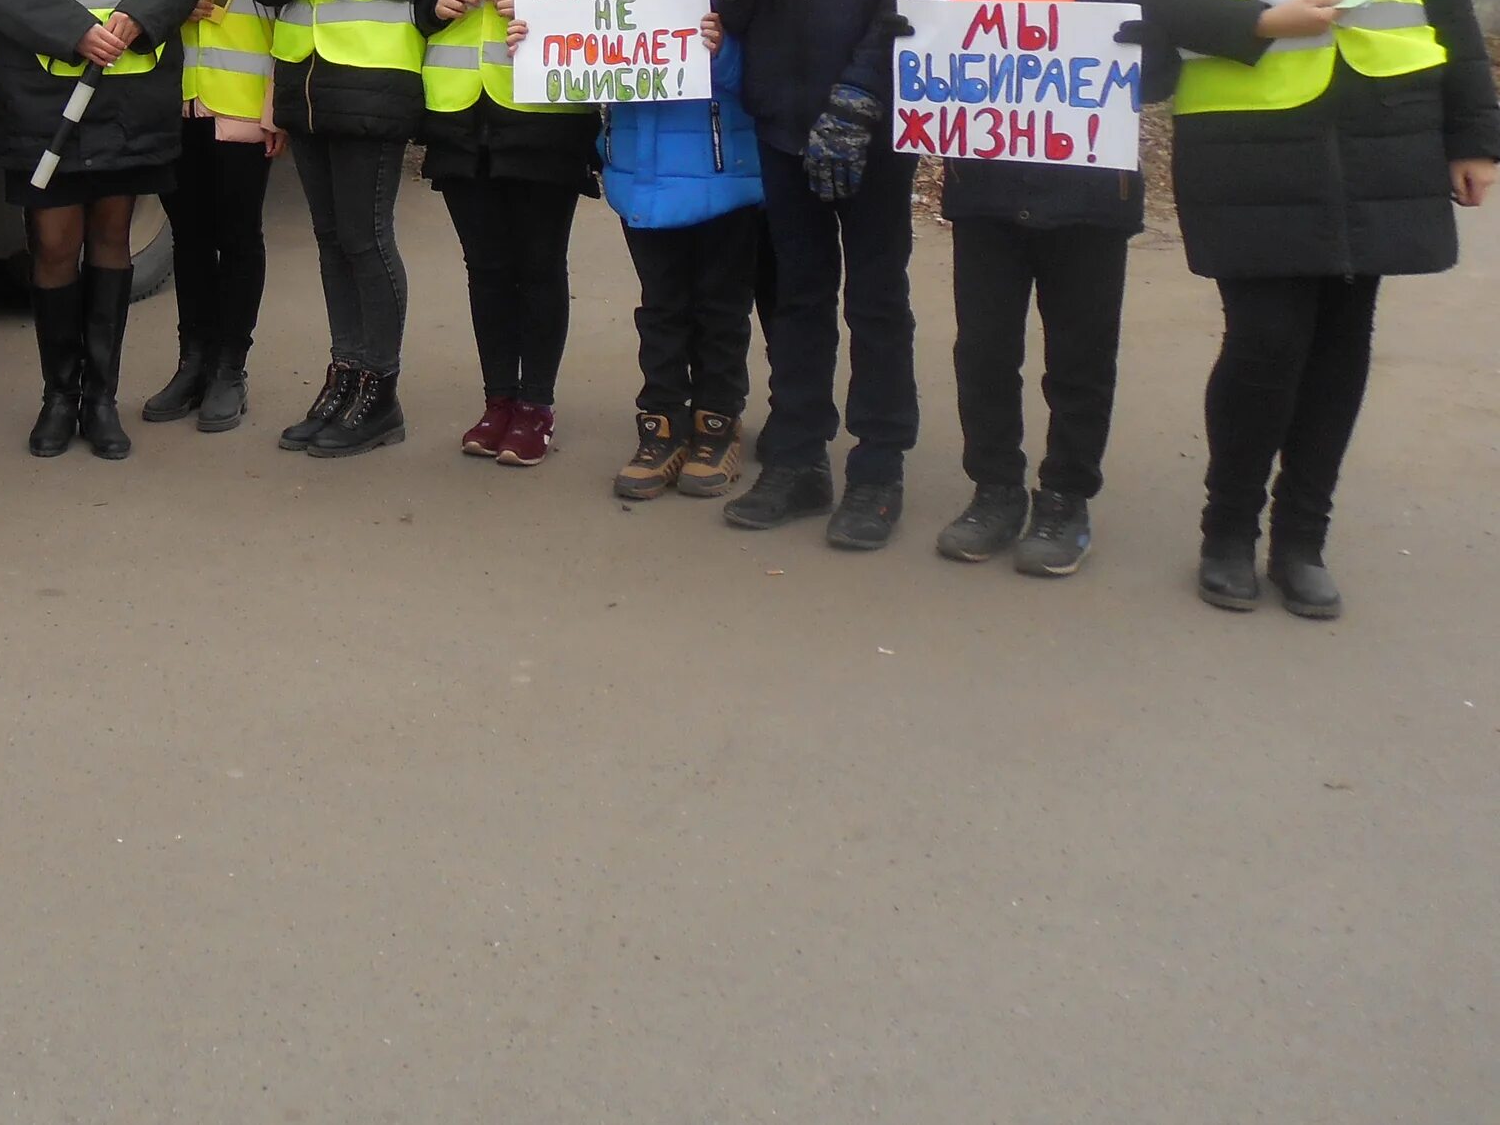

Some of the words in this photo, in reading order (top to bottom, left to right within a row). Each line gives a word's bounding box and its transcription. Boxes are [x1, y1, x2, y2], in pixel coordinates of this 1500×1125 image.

[543, 28, 698, 67] ПРОЩАЕТ
[961, 3, 1059, 51] МЫ
[546, 67, 684, 102] ОШИБОК!
[899, 50, 1142, 113] ВЫБИРАЕМ
[895, 106, 1100, 163] ЖИЗНЬ!
